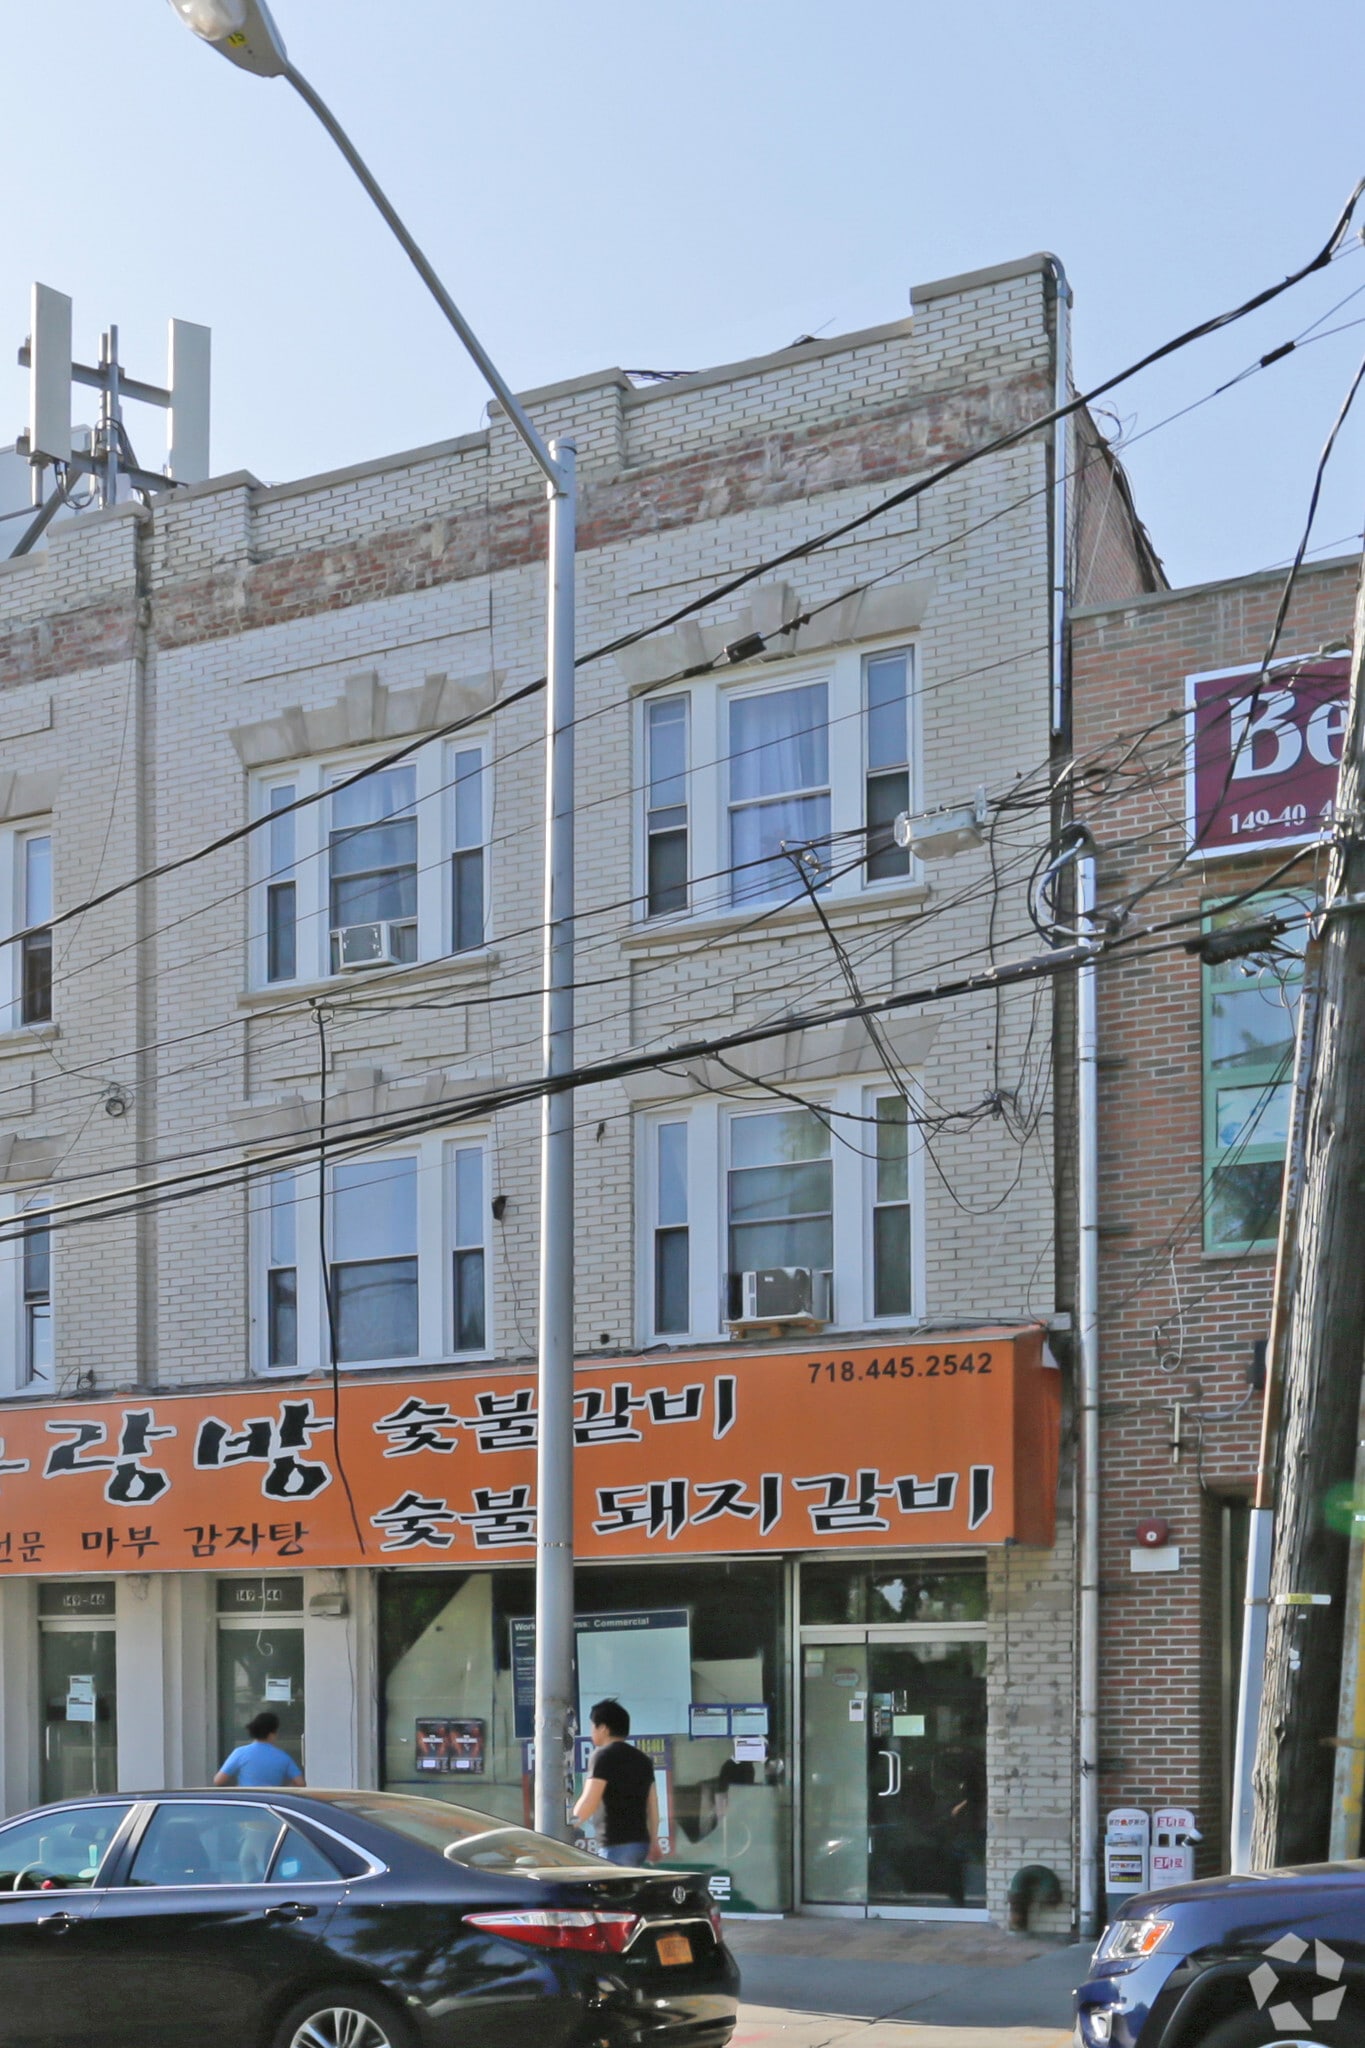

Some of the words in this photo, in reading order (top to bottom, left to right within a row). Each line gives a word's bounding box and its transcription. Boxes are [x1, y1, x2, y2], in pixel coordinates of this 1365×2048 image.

[808, 1351, 994, 1384] 718.445.2542
[0, 1398, 336, 1507] 랑방
[593, 1464, 993, 1540] 돼지갈비
[81, 1525, 160, 1560] 마부
[183, 1521, 310, 1558] 감자탕
[593, 1616, 650, 1629] Commercial
